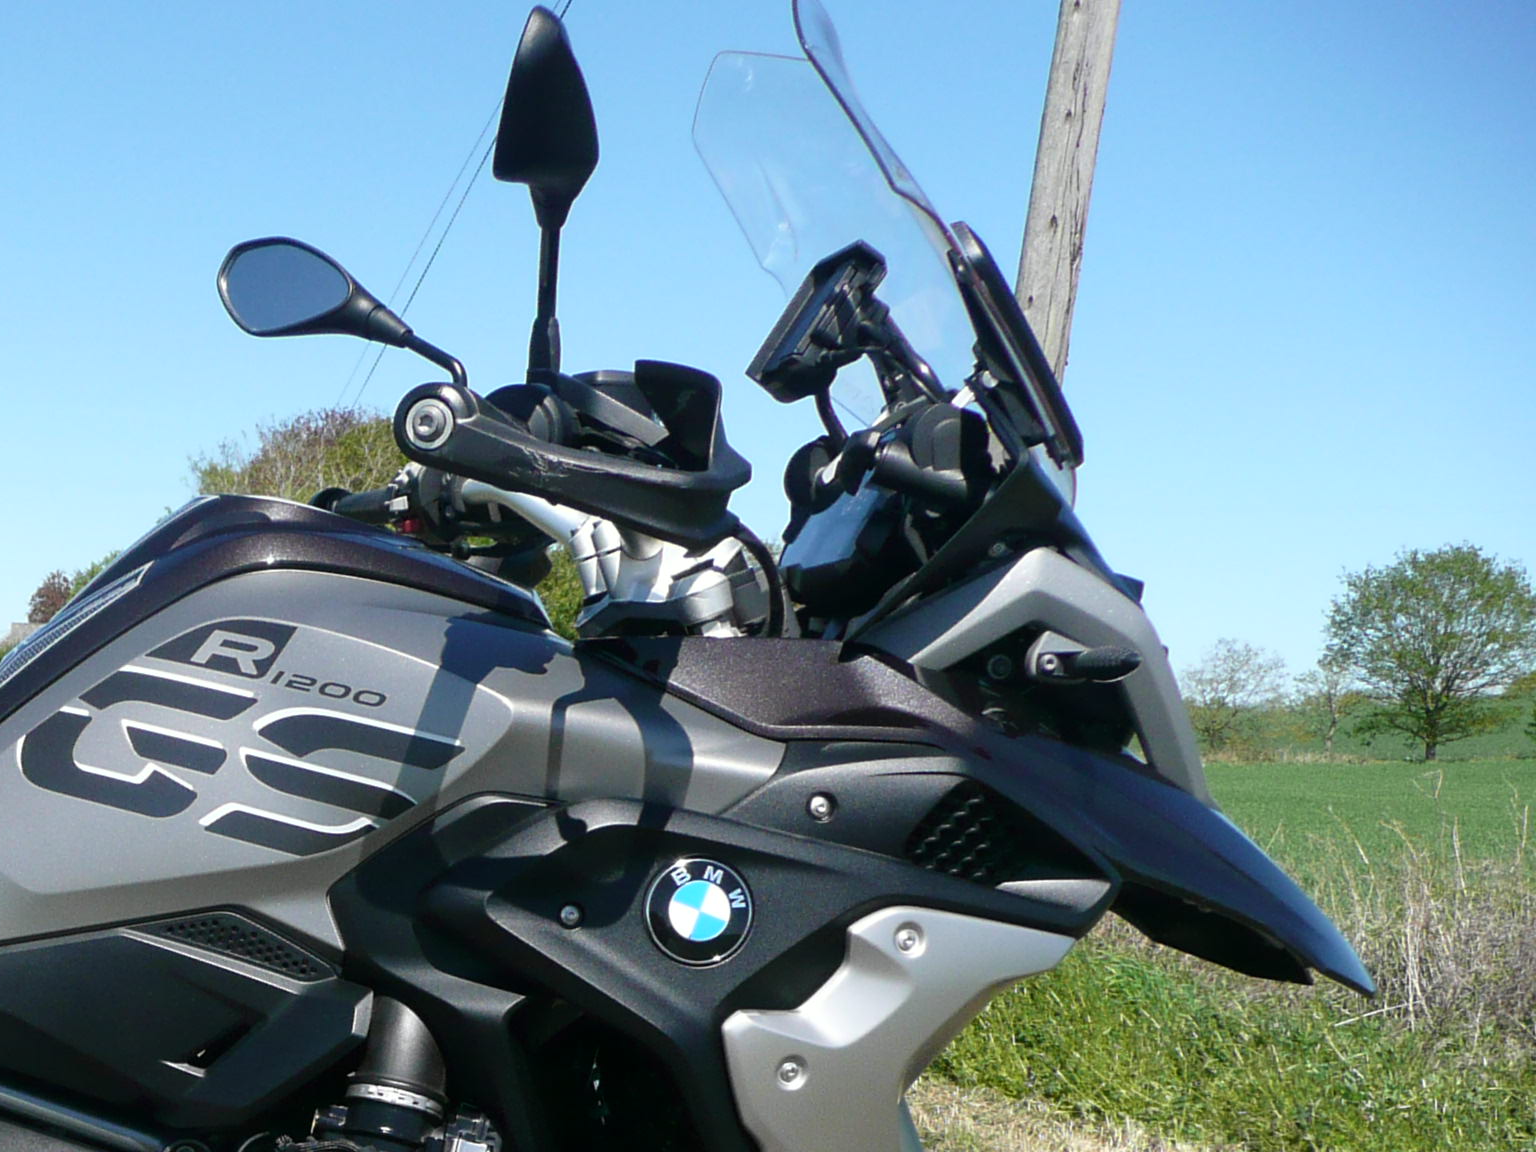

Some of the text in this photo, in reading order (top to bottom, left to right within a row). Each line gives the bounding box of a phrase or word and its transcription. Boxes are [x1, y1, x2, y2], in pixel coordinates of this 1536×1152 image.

[191, 629, 387, 707] R 1200
[16, 664, 466, 857] GS
[670, 865, 747, 909] BMW
